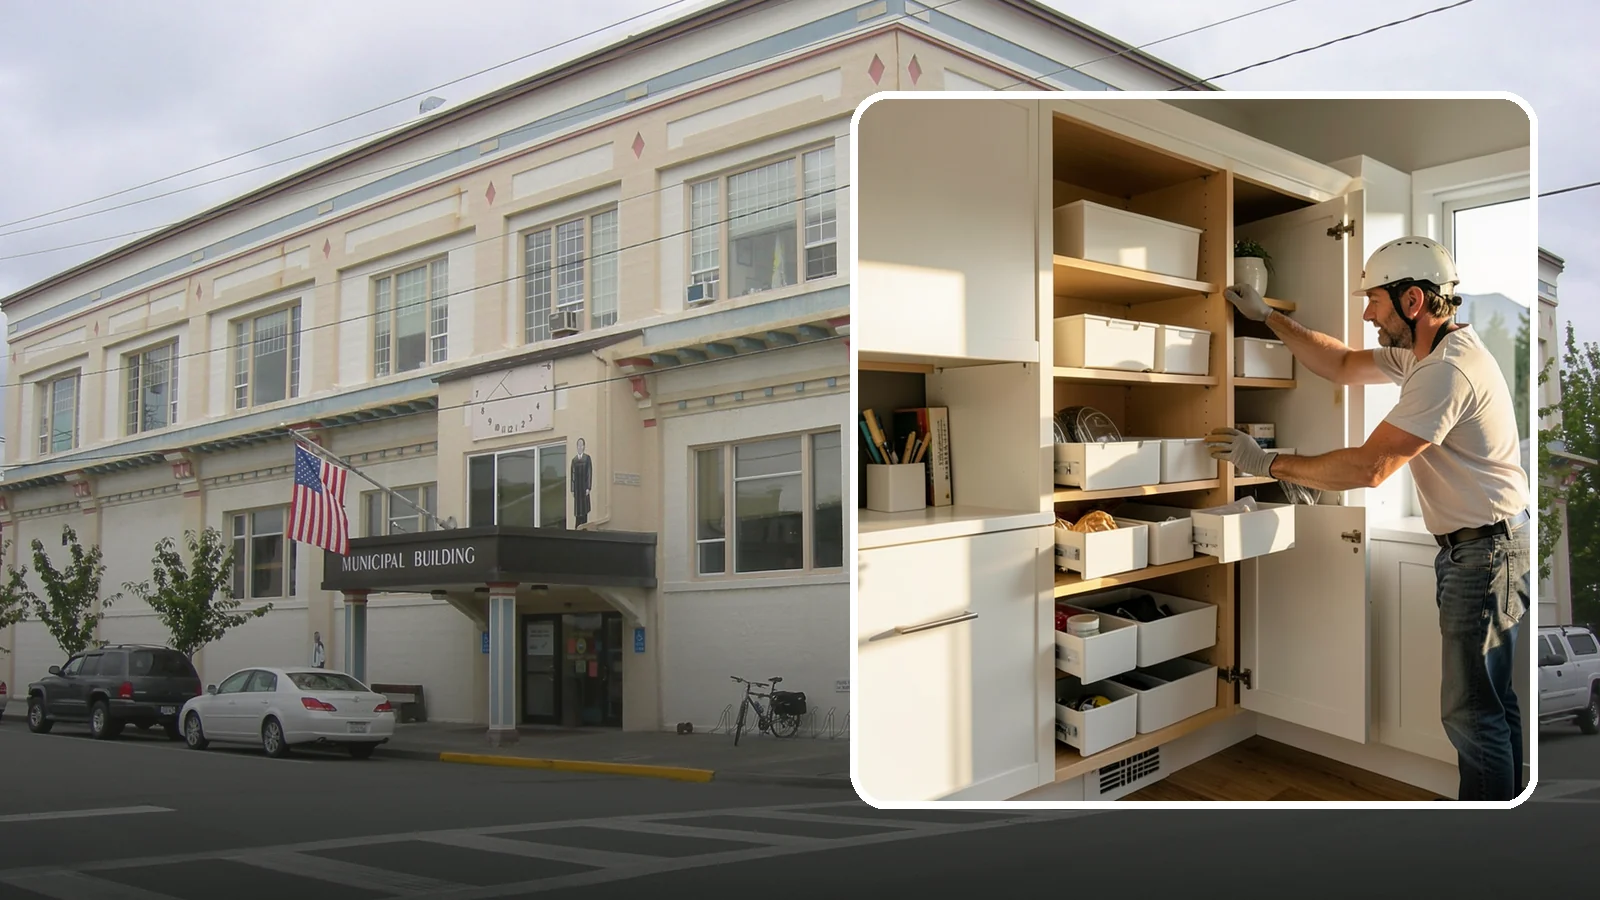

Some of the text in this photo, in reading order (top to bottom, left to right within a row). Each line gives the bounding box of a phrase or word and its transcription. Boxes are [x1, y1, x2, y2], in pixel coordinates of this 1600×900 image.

[494, 423, 500, 432] 10
[507, 425, 513, 434] 12
[342, 546, 475, 572] MUNICIPAL BUILDING
